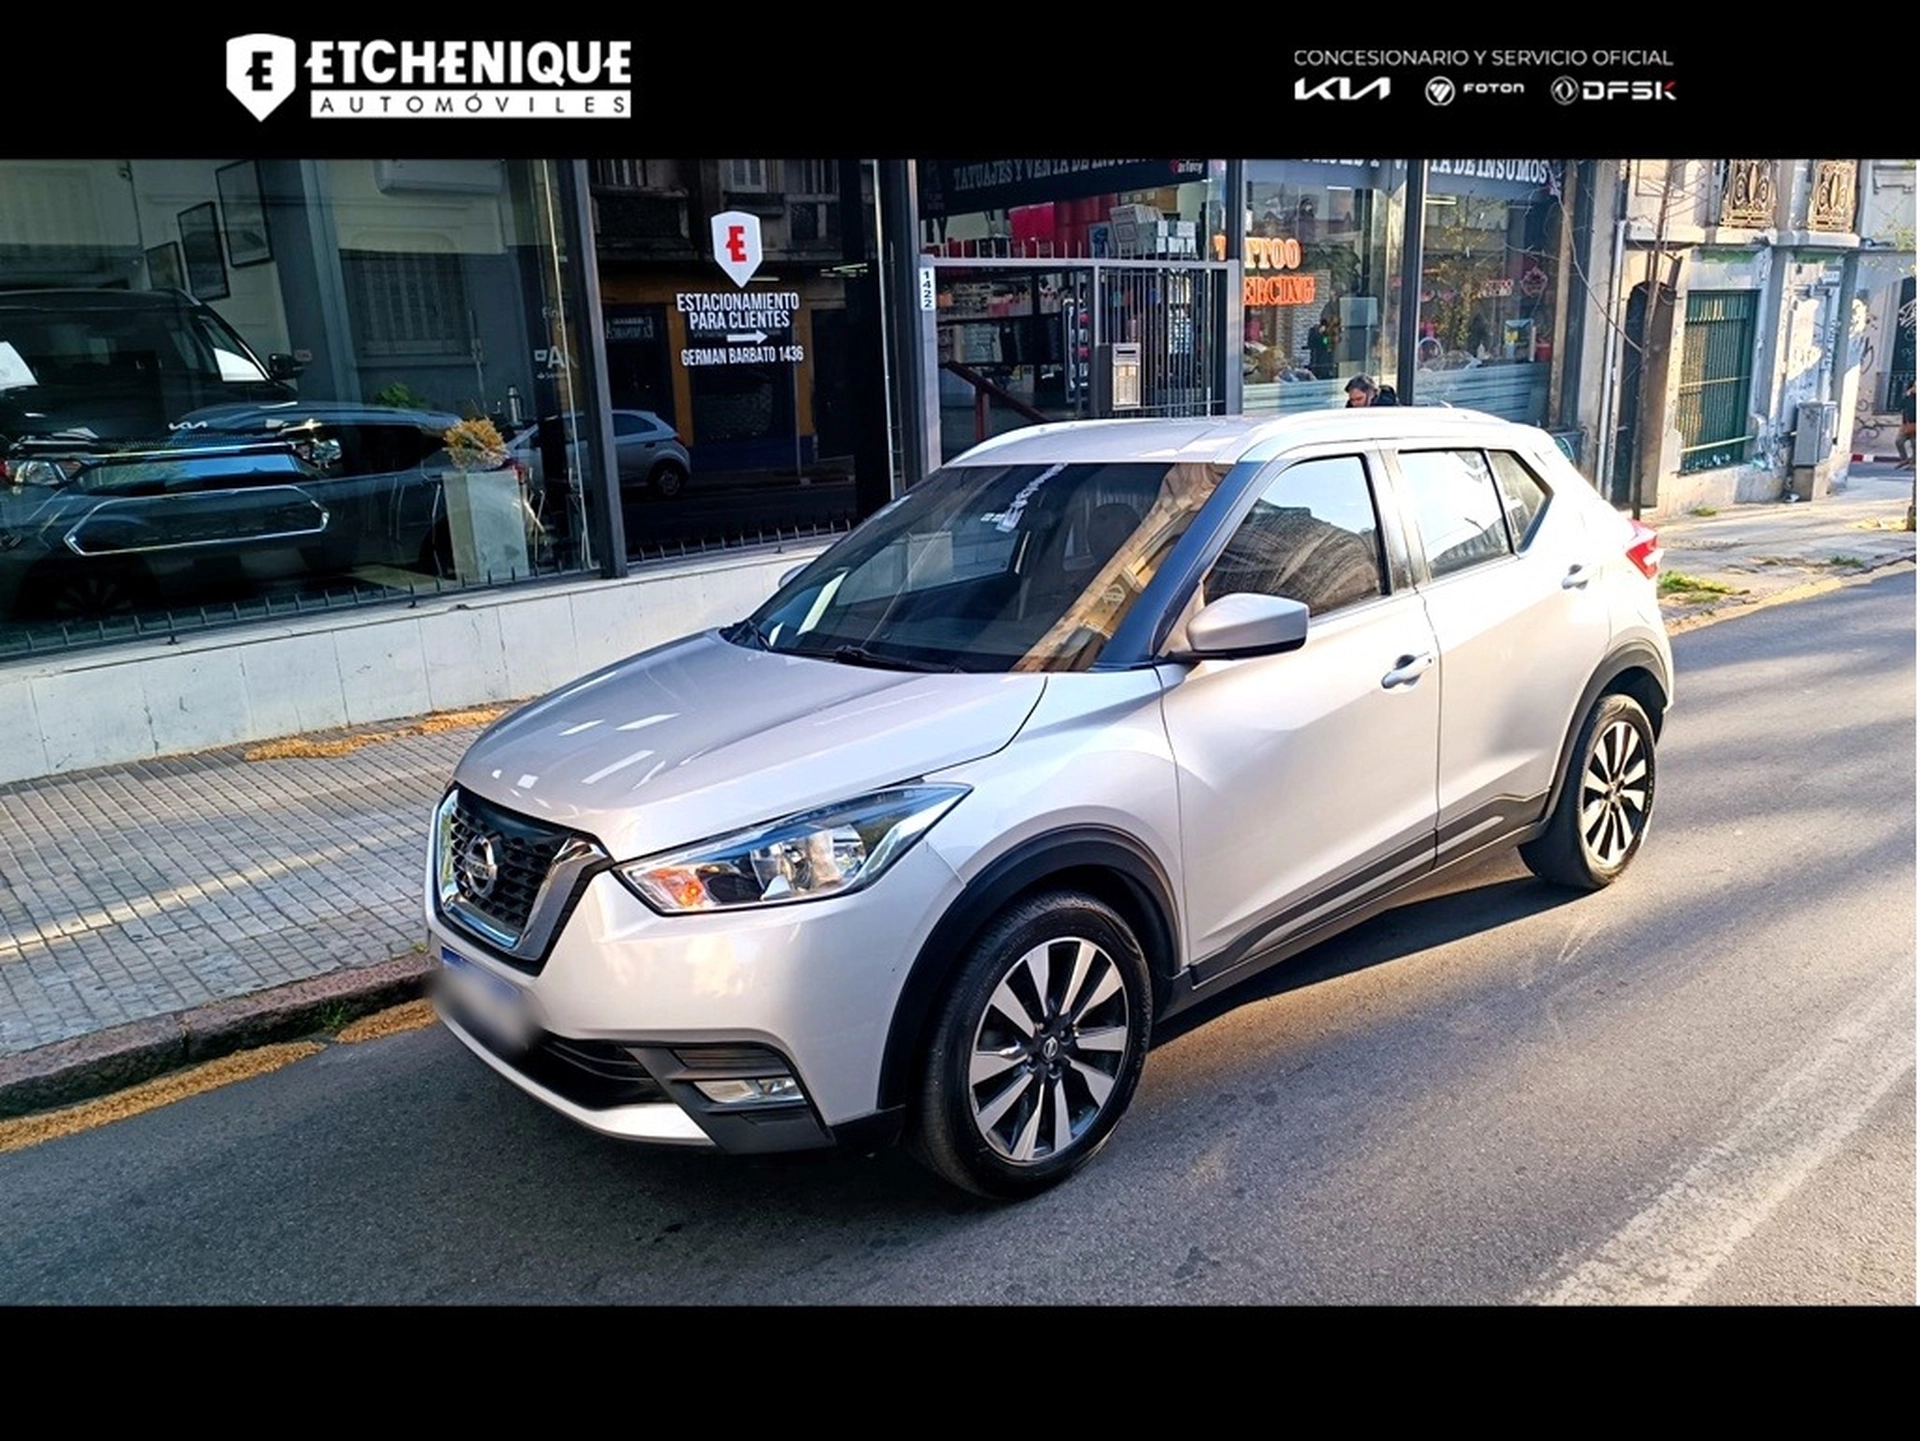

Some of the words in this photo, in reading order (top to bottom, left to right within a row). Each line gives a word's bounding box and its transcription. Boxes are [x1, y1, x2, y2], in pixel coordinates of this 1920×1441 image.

[922, 270, 932, 308] 1422
[676, 292, 800, 312] ESTACIONAMIENTO
[689, 311, 727, 330] PARA
[728, 310, 791, 329] CLIENTES
[680, 347, 727, 366] GERMAN
[728, 346, 776, 364] BARBATO
[778, 345, 804, 362] 1436
